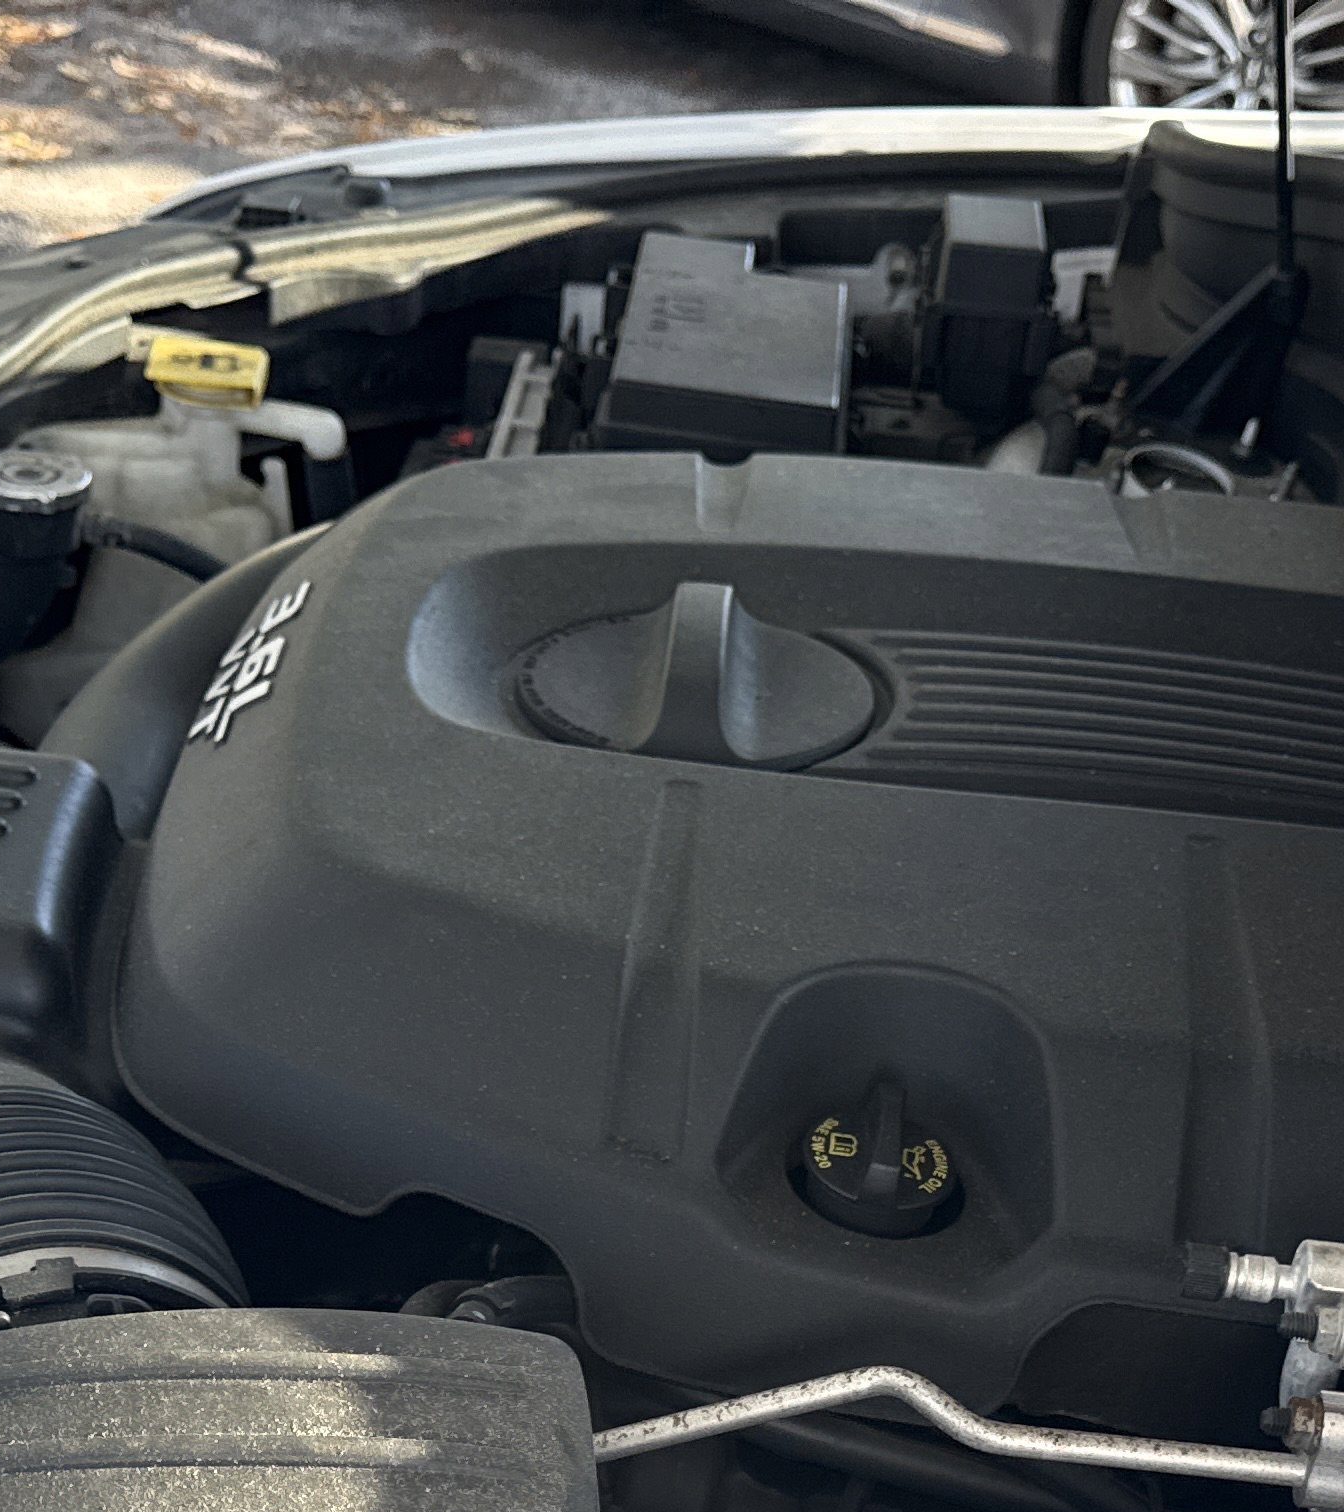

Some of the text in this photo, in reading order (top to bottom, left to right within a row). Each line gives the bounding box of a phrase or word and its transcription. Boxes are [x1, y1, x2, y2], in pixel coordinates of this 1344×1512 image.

[212, 580, 314, 743] 3.6L
[917, 1138, 950, 1195] ENGINE OIL
